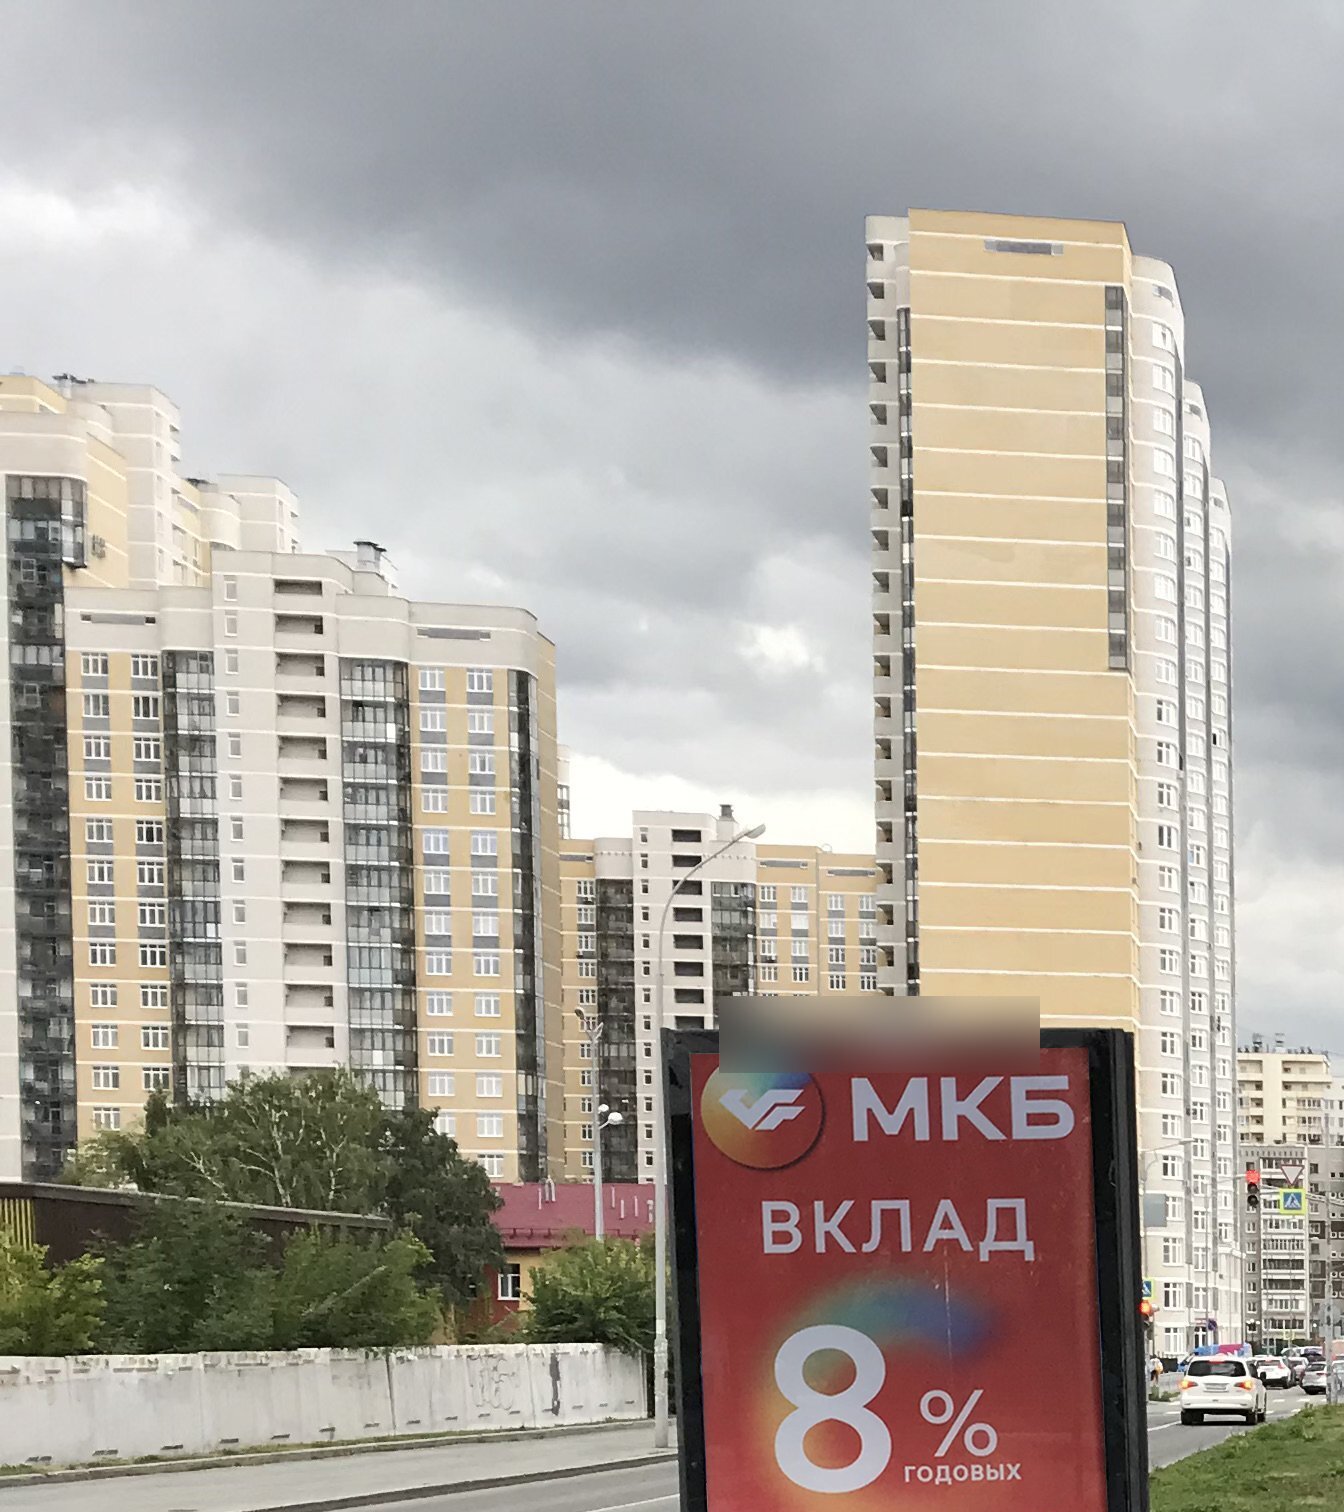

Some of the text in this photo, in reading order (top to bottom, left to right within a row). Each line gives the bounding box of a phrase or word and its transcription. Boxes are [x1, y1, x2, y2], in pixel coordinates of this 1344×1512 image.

[851, 1075, 1075, 1142] МКБ
[762, 1198, 1035, 1262] ВКЛАД
[774, 1324, 998, 1494] 8 %
[904, 1462, 1022, 1485] годовых
